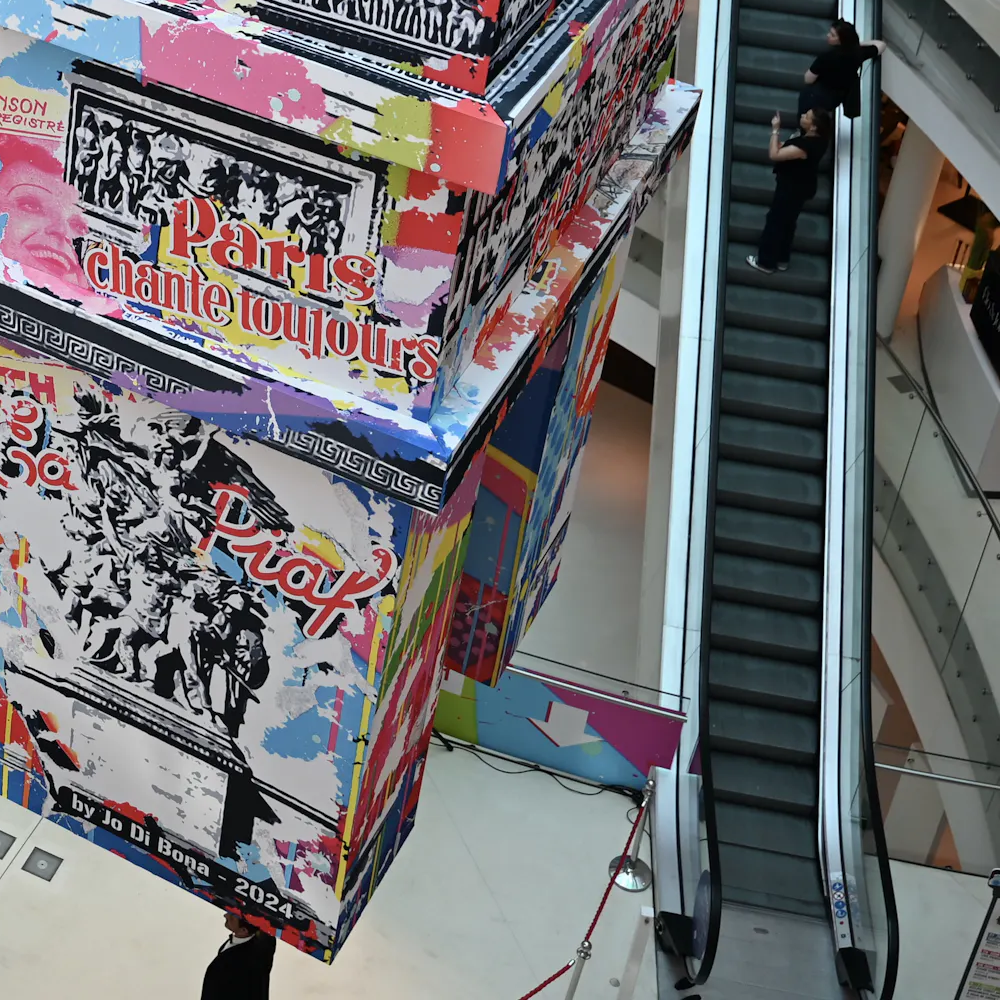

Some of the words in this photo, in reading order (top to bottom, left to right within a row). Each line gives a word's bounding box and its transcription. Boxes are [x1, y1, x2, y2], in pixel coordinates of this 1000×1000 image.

[85, 240, 229, 325] chante
[238, 290, 440, 380] toujours
[171, 196, 376, 304] Paris
[197, 481, 396, 638] Piaf
[71, 793, 95, 818] by
[101, 807, 123, 832] Jo
[129, 823, 151, 847] Di
[157, 836, 210, 879] Bona
[234, 876, 294, 920] 2024
